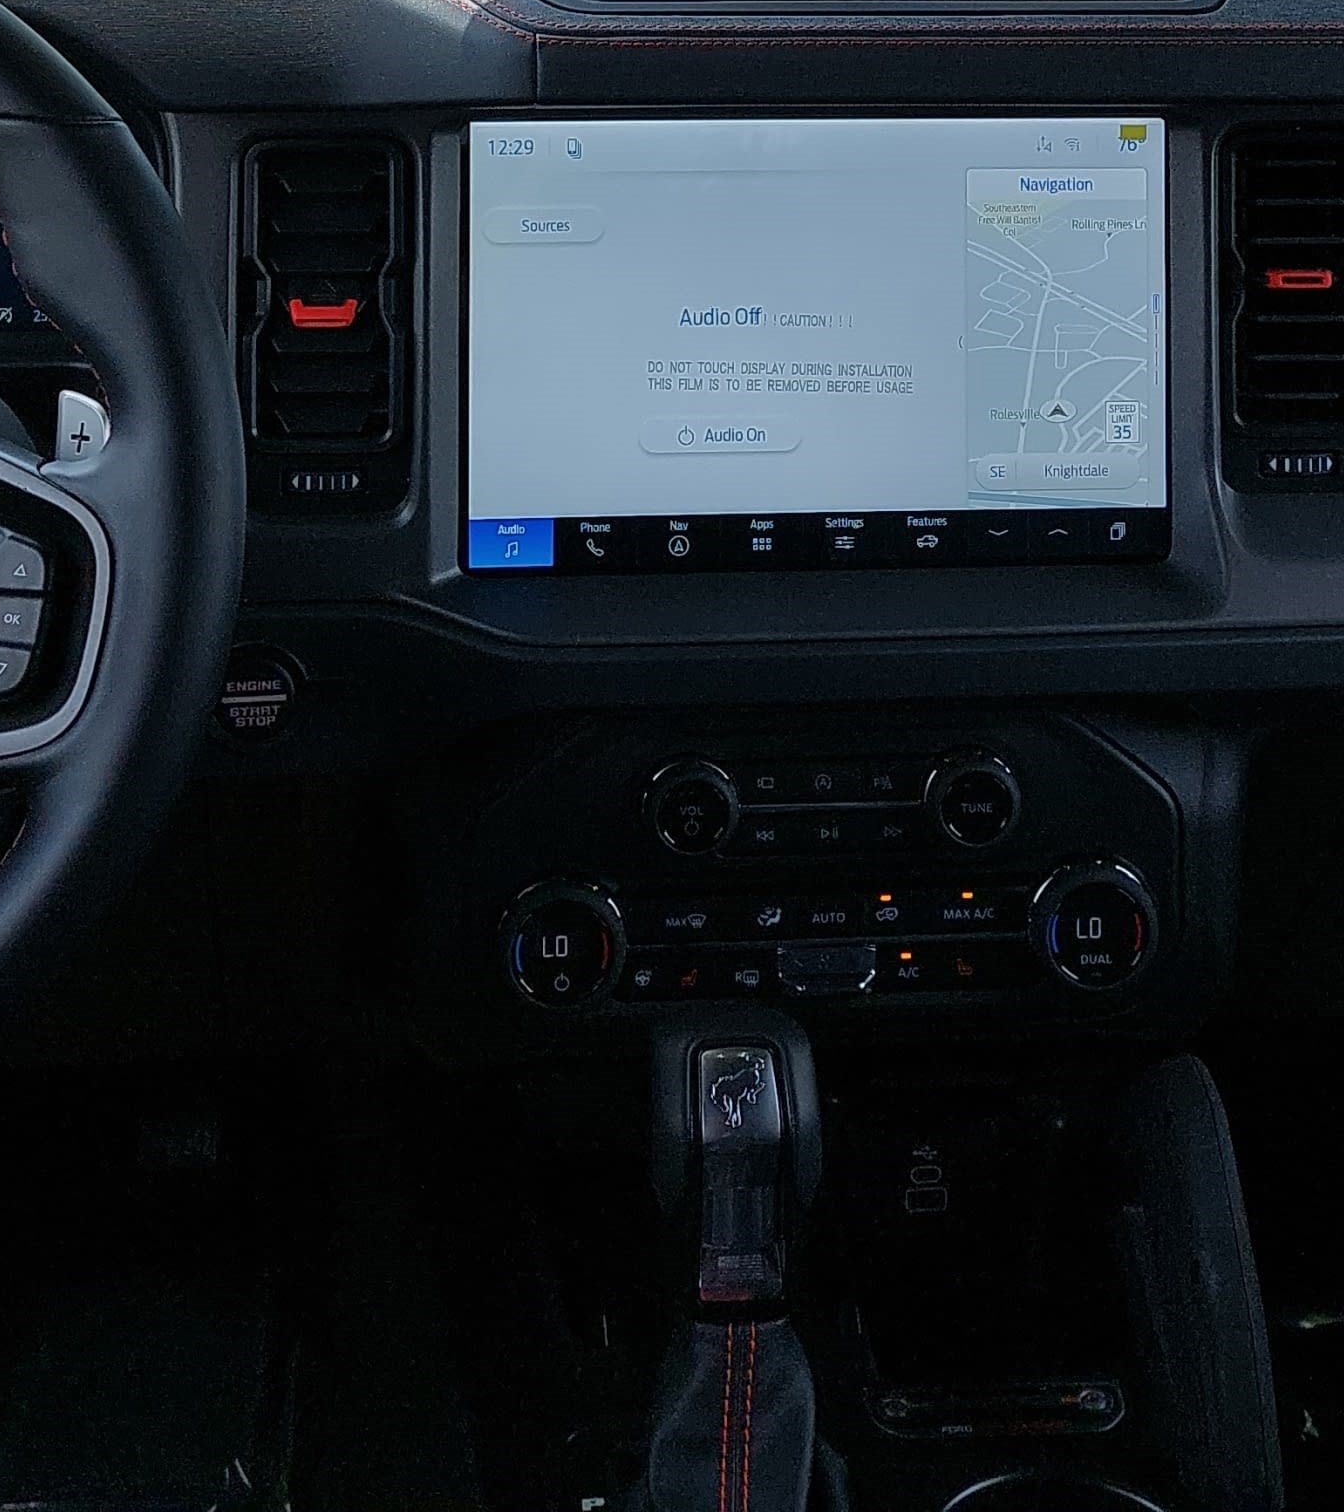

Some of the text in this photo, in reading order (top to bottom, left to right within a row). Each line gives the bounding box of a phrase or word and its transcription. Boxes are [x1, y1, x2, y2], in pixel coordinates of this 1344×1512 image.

[488, 140, 535, 156] 12:29
[1020, 177, 1094, 194] Navigation
[983, 203, 1037, 214] Southeastern
[521, 219, 571, 233] Sources
[978, 214, 1041, 226] Free Will Baptist
[1071, 219, 1105, 231] Rolling
[1107, 218, 1133, 230] Pines
[679, 306, 763, 326] Audio Off
[647, 360, 913, 379] DO NOT TOUCH DISPLAY DURING INSTALLATION
[647, 377, 914, 394] THIS FILM IS TO BE REMOVED BEFORE USAGE
[990, 408, 1040, 420] Rolesville
[1108, 404, 1136, 414] SPEED
[1111, 414, 1134, 424] LIMIT
[704, 428, 766, 443] Audio On
[1113, 425, 1132, 440] 35
[990, 464, 1109, 479] SE Knightdale
[580, 521, 611, 534] Phone
[670, 520, 689, 531] Nav
[750, 519, 774, 532] Apps
[825, 516, 865, 530] Settings
[907, 516, 948, 528] Features
[497, 524, 526, 535] Audio
[4, 613, 22, 625] OK
[226, 679, 282, 693] ENGINE
[229, 704, 281, 718] START
[235, 715, 277, 728] STOP
[679, 805, 705, 817] VOL
[960, 803, 994, 815] TUNE
[811, 912, 846, 924] AUTO
[943, 907, 995, 920] MAX A/C
[666, 917, 688, 928] MAX
[1080, 953, 1113, 966] DUAL
[897, 966, 920, 979] A/C
